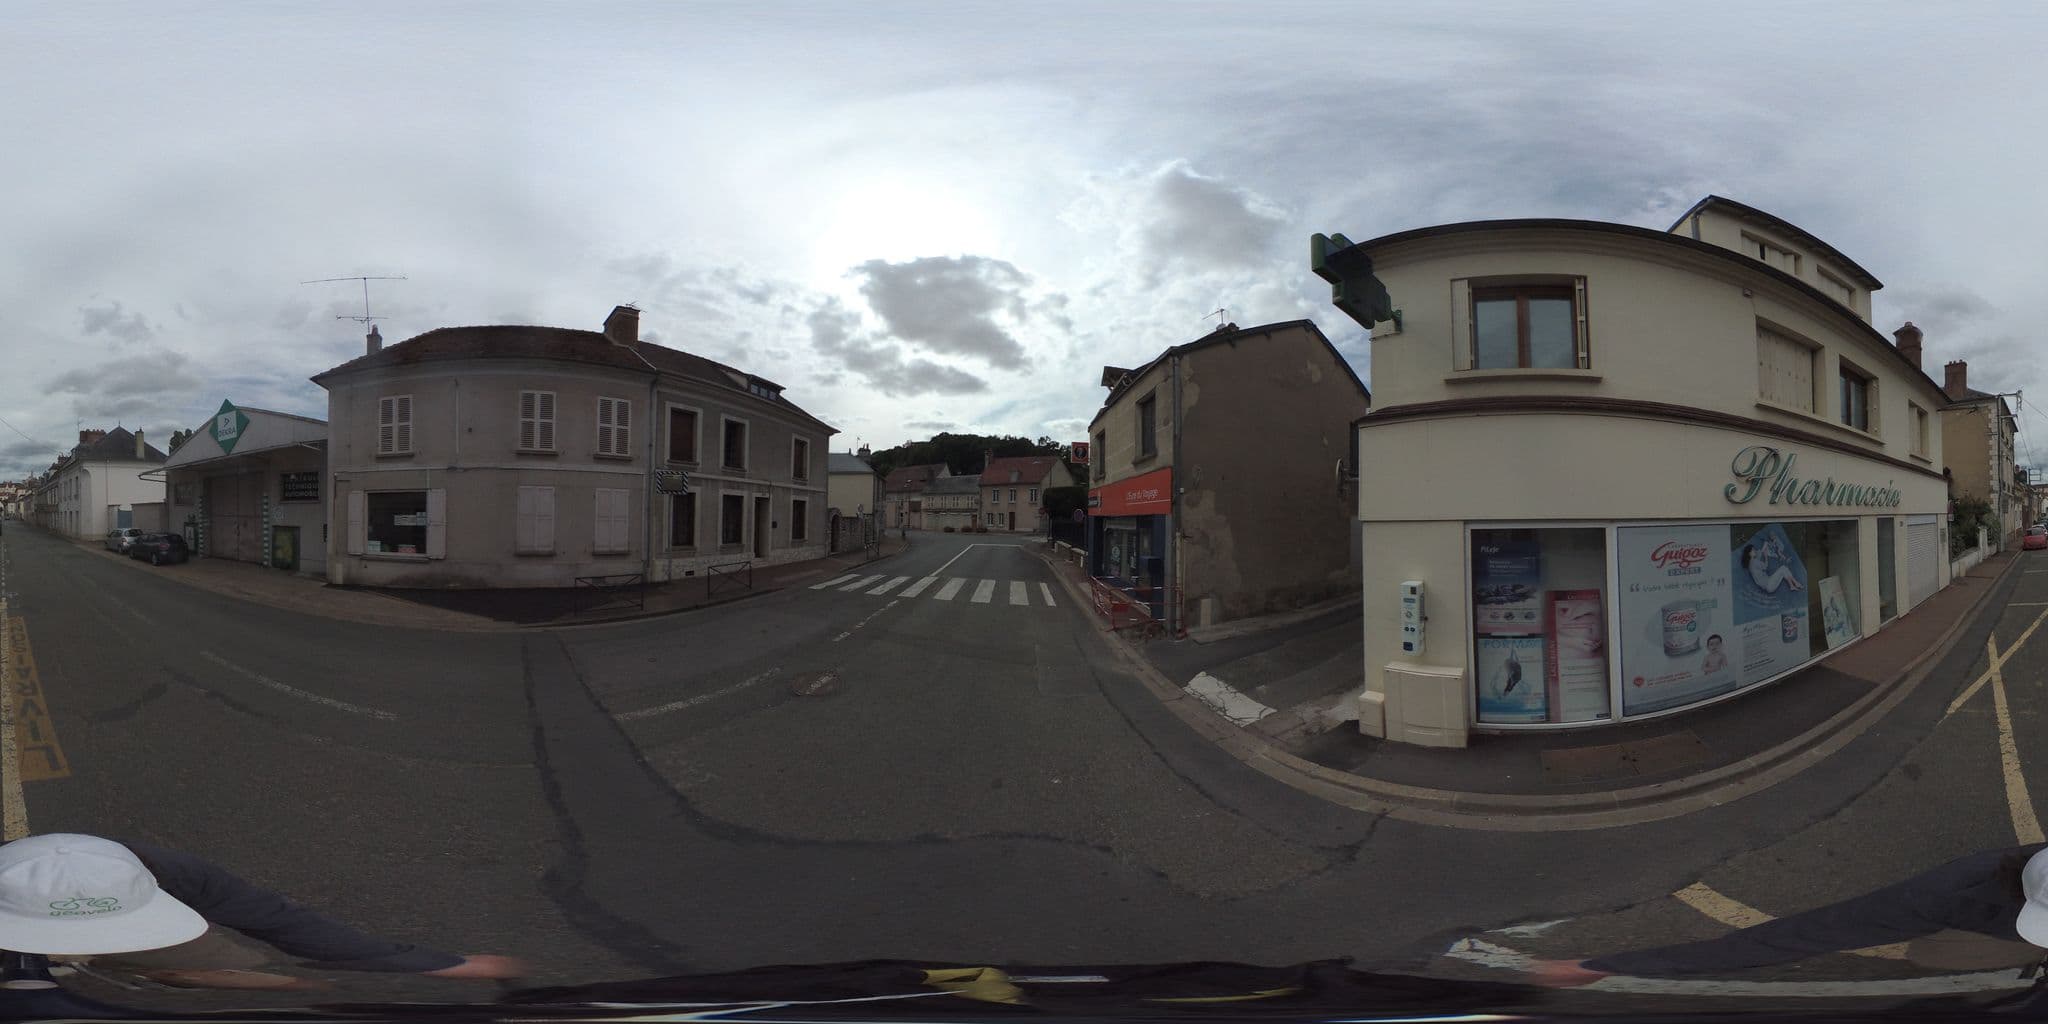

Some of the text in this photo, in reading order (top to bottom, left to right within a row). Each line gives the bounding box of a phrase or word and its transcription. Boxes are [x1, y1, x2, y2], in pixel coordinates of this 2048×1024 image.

[218, 427, 236, 437] DEKRA
[1724, 446, 1902, 508] Pharmacie
[1651, 541, 1707, 568] Guigoz
